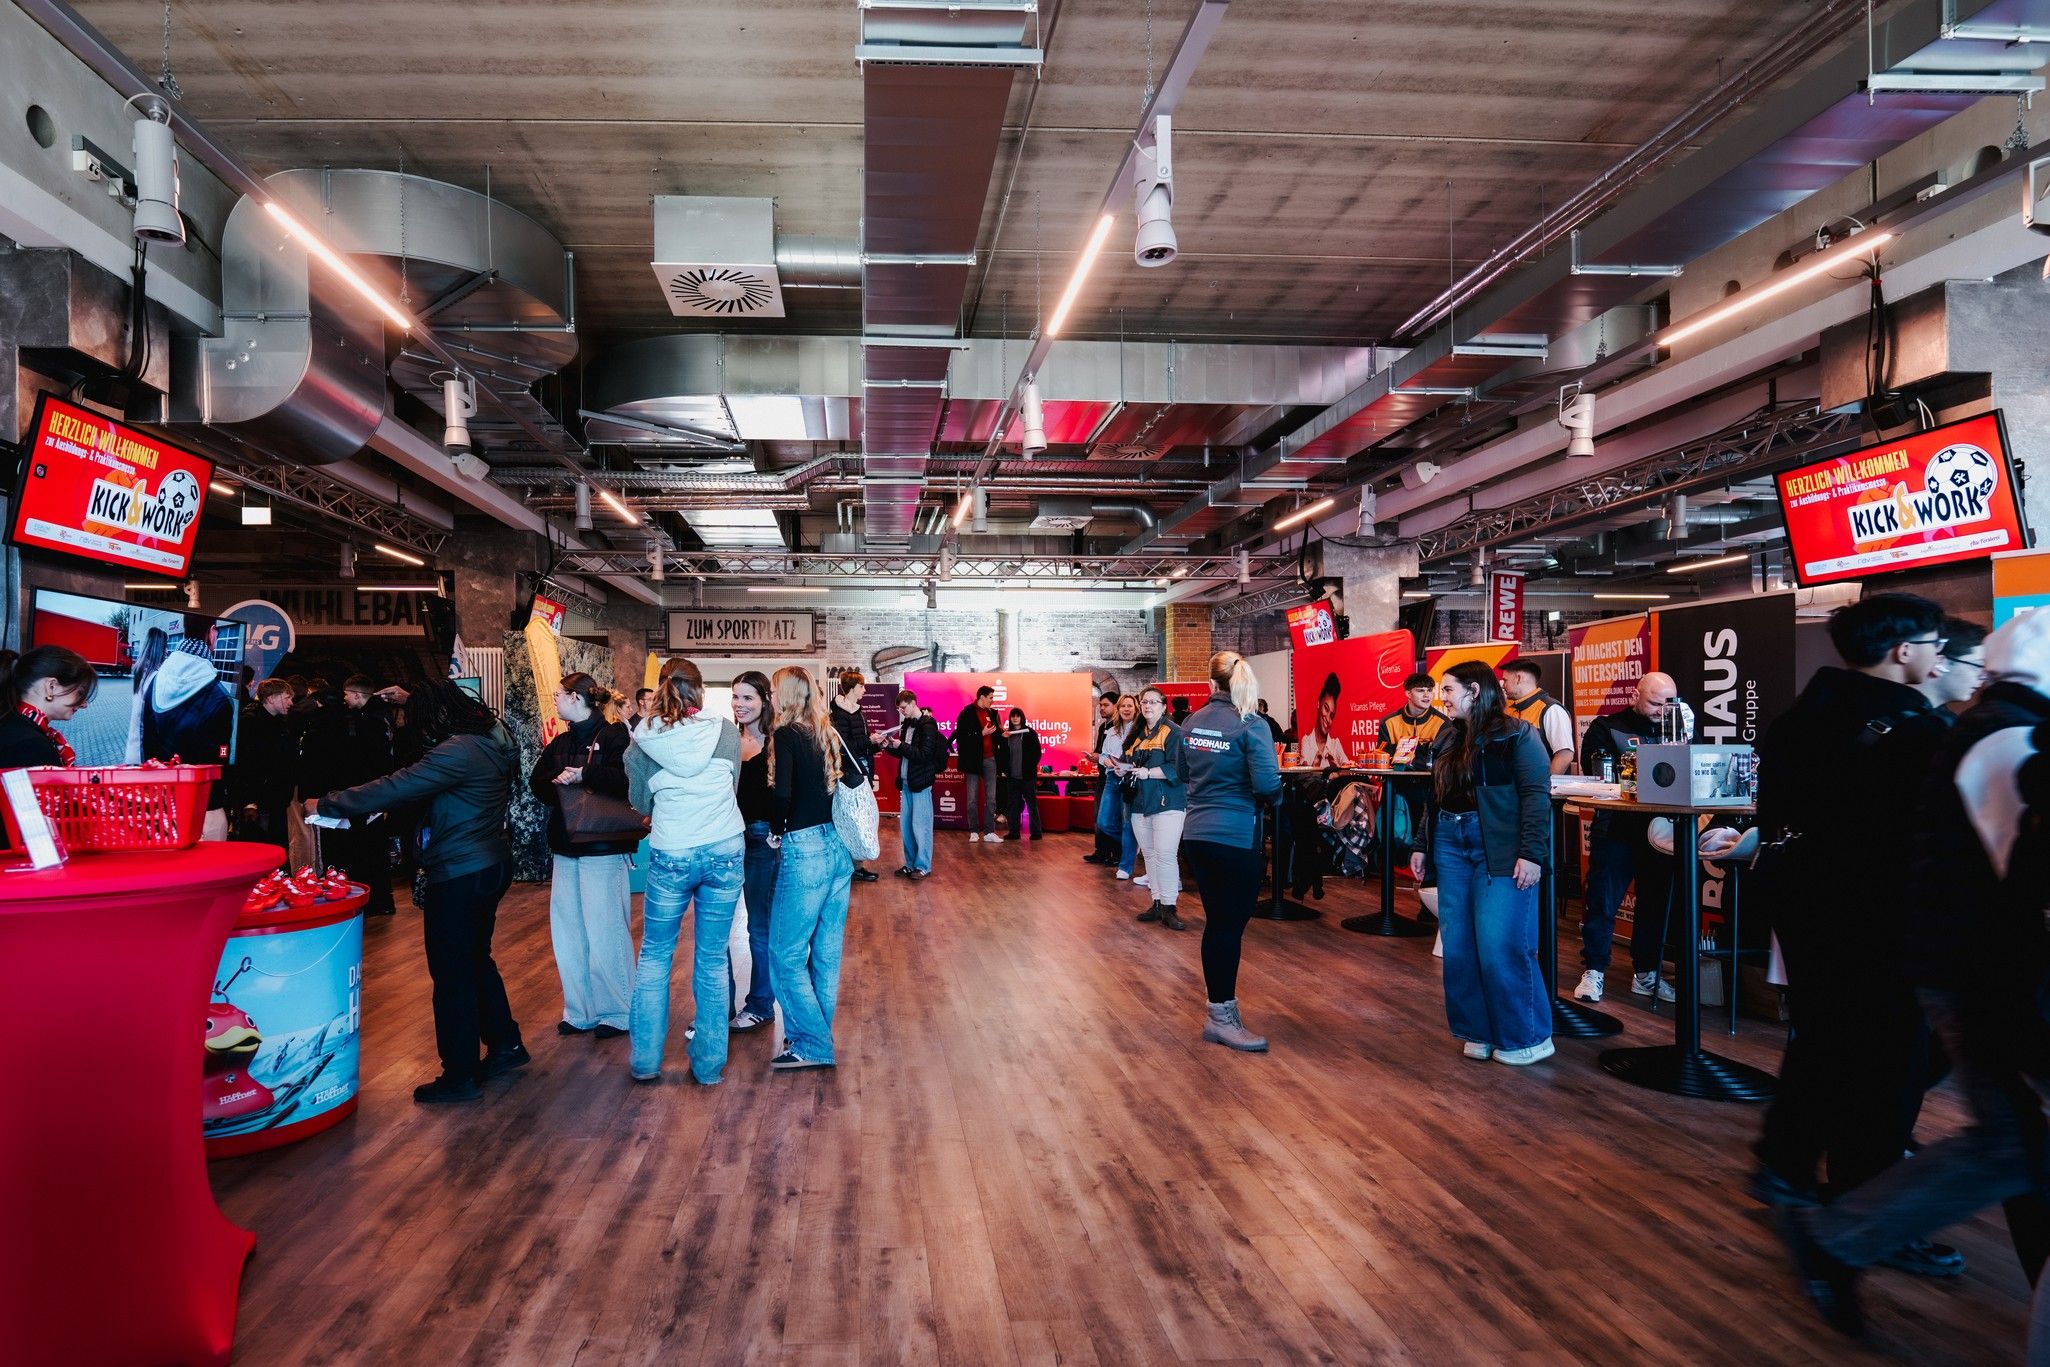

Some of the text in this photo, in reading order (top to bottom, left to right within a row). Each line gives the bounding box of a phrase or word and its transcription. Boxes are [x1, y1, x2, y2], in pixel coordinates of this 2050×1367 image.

[49, 410, 160, 470] HERZLICH WILLKOMMEN
[1785, 449, 1910, 497] HERZLICH WILLKOMMEN
[91, 485, 133, 523] KICK
[142, 504, 185, 538] WORK
[1852, 503, 1899, 538] KICK
[1913, 485, 1983, 524] WORK
[686, 619, 797, 640] ZUM SPORTPLATZ
[1498, 576, 1517, 640] REWE
[246, 623, 281, 651] VG
[1574, 638, 1643, 662] DU MACHST DEN
[1351, 719, 1380, 736] ARBE
[1743, 680, 1759, 742] Gruppe
[1189, 737, 1231, 750] BODENHAUS
